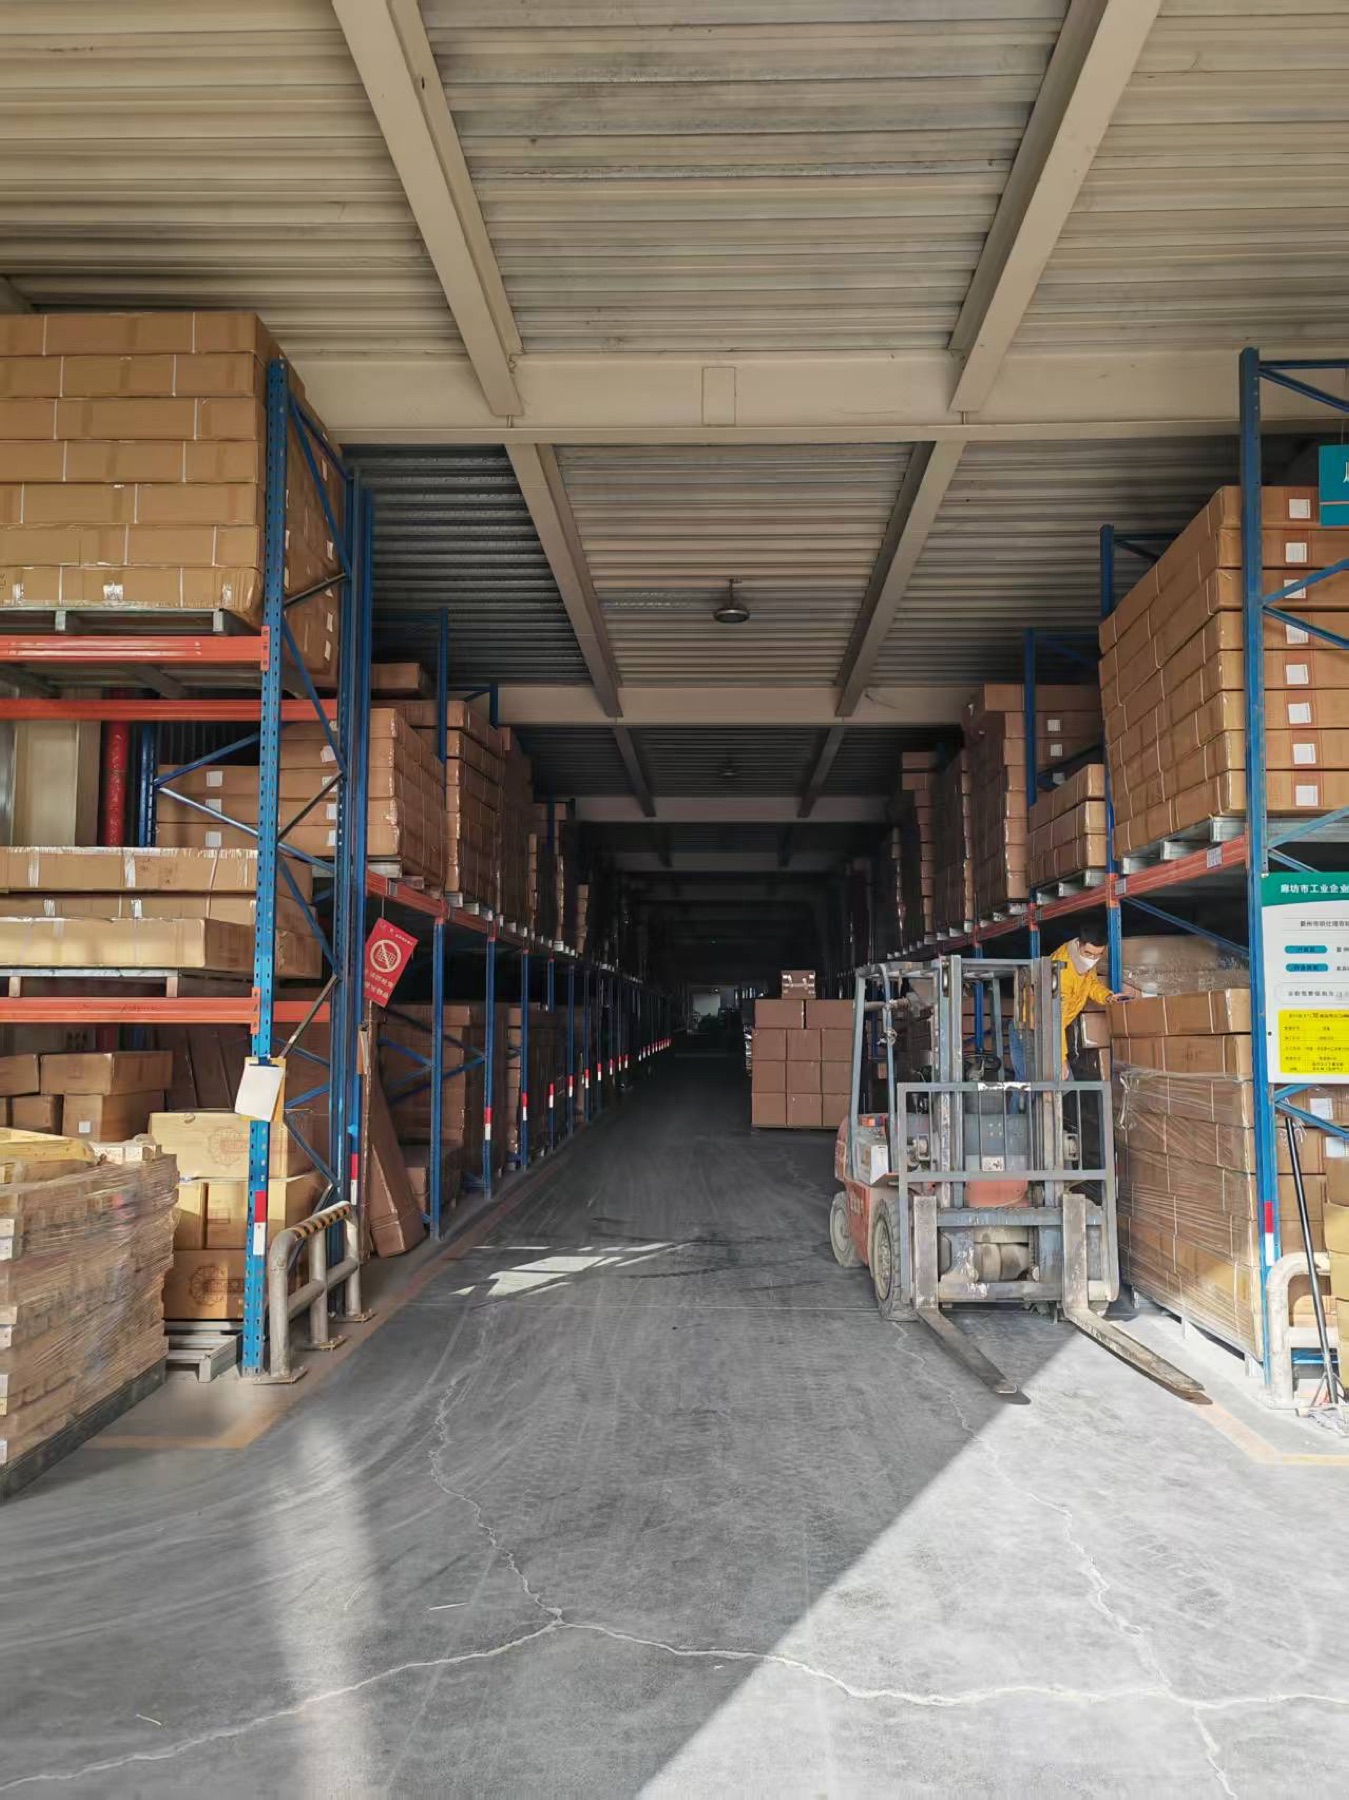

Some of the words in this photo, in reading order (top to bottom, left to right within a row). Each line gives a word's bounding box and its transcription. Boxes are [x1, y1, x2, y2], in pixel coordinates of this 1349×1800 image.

[1281, 884, 1349, 894] 廊坊市工业企业
